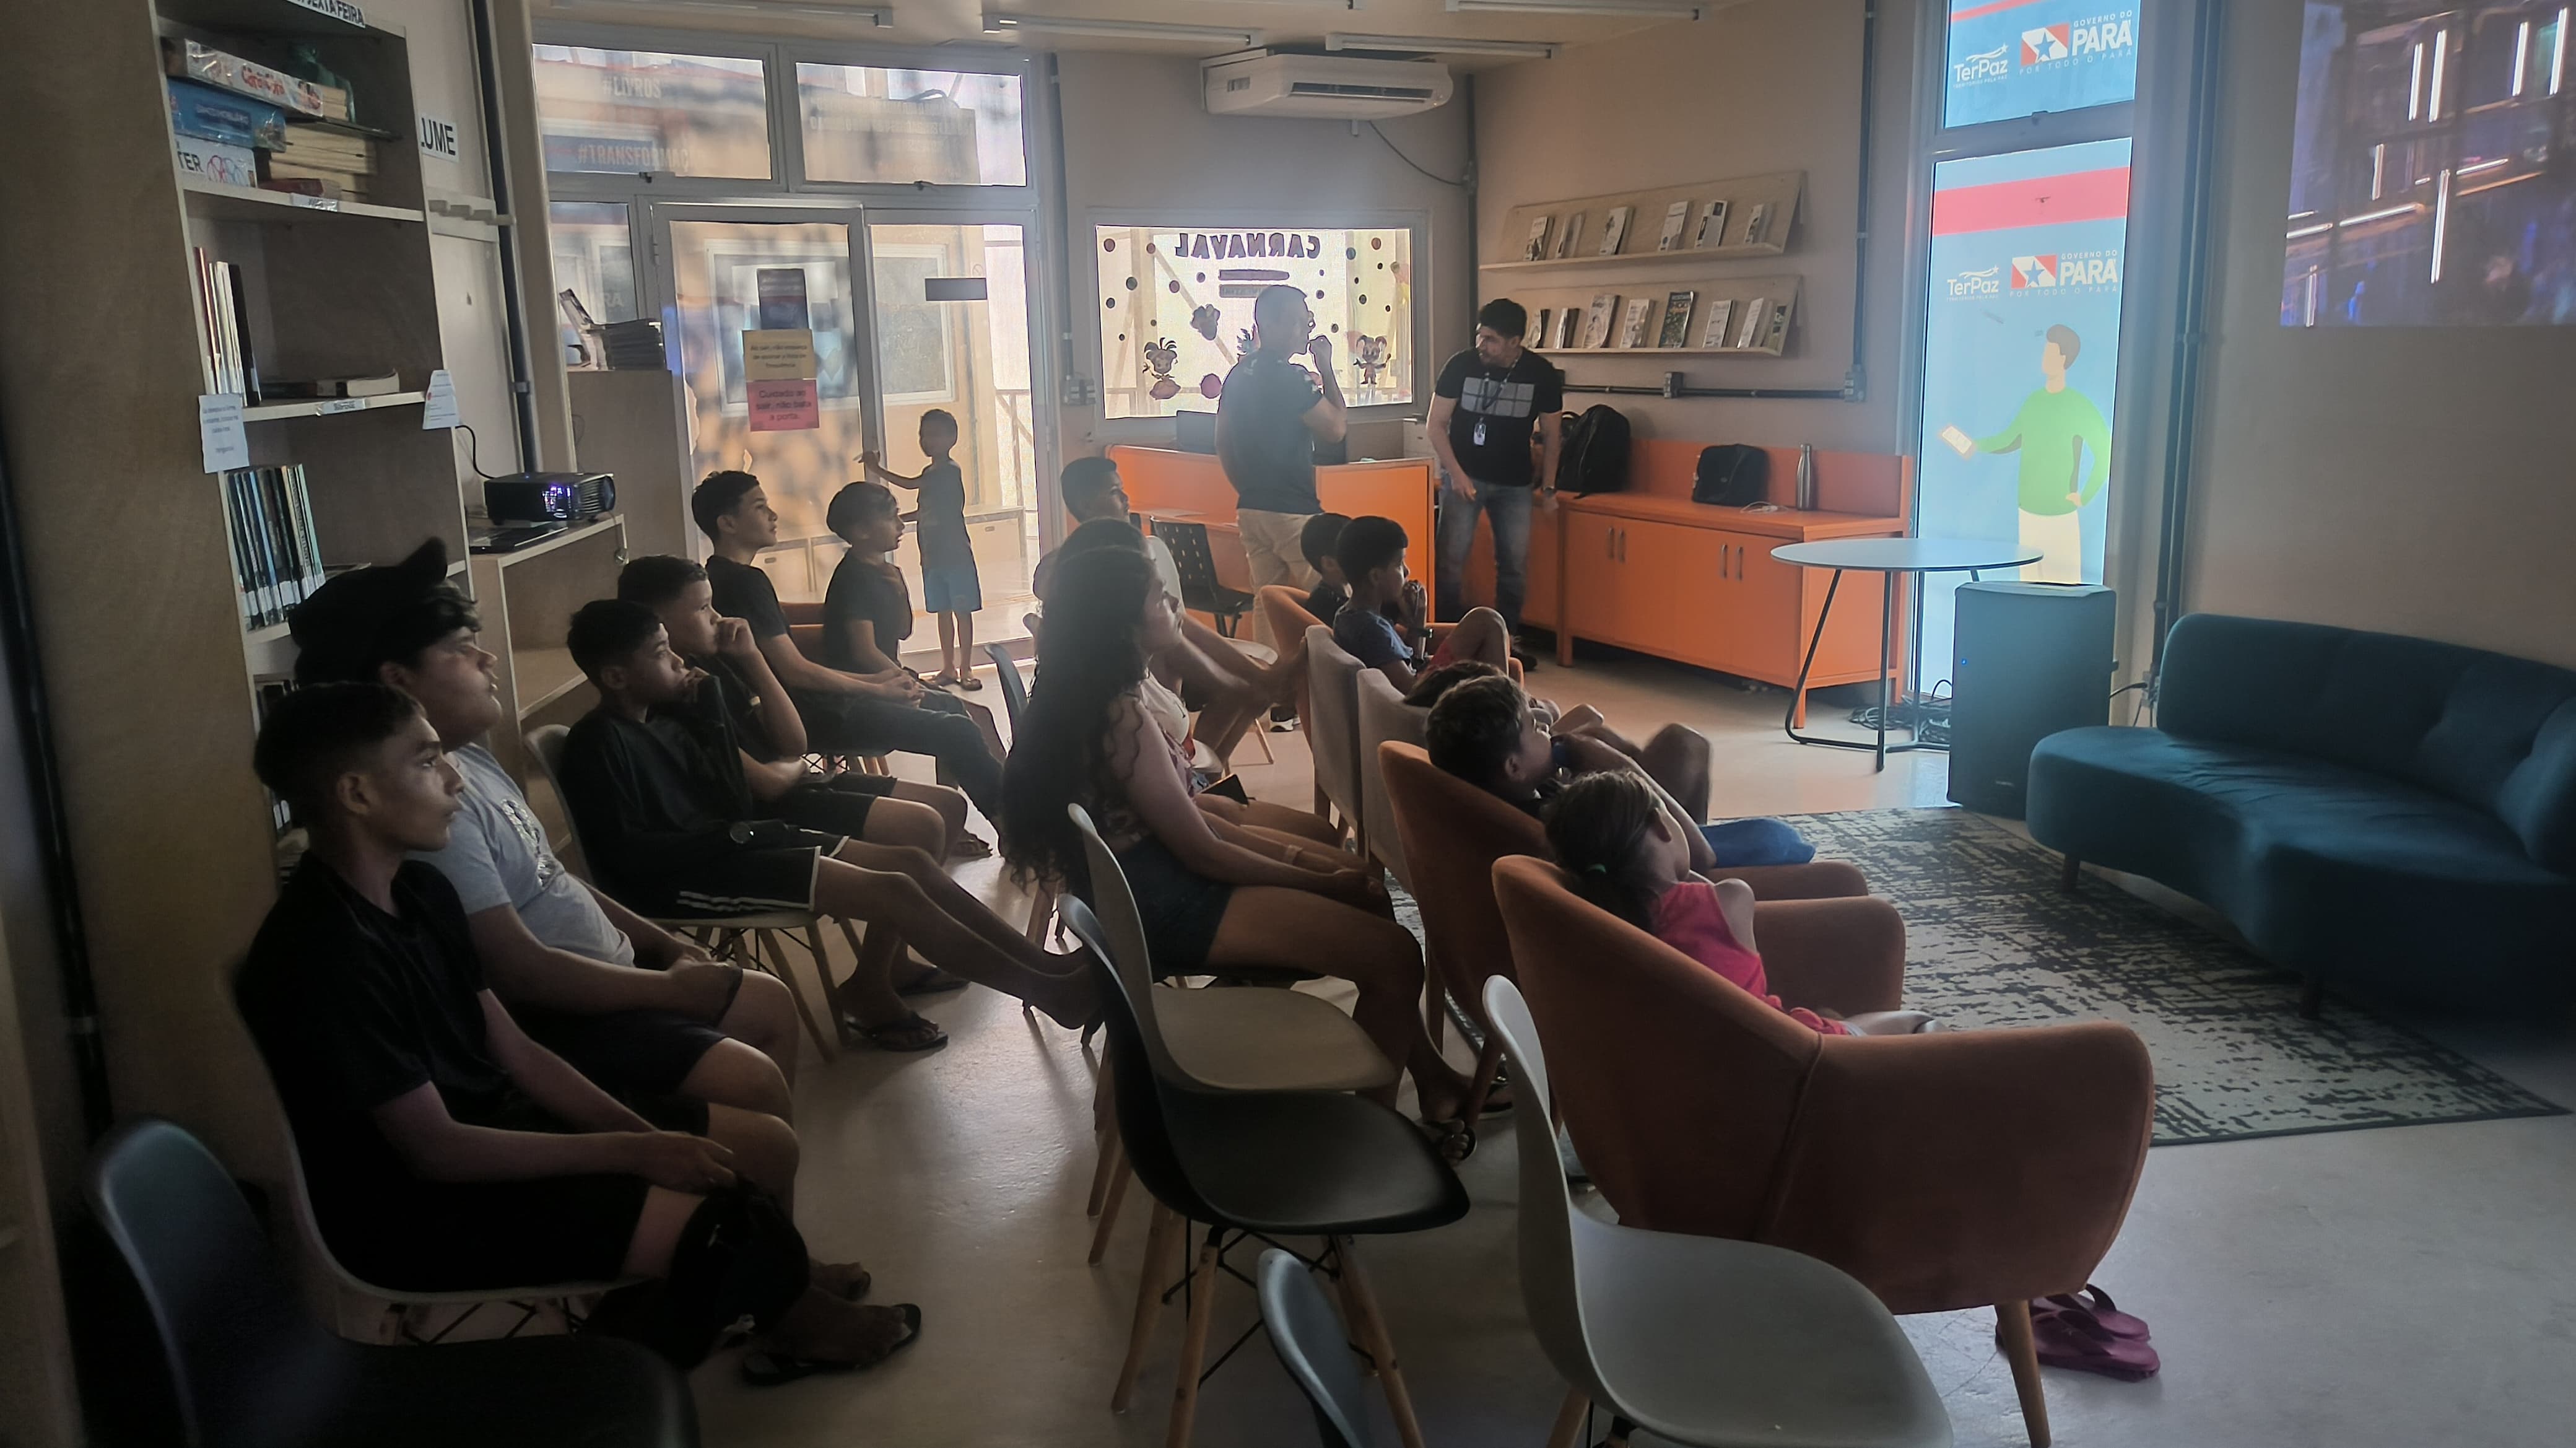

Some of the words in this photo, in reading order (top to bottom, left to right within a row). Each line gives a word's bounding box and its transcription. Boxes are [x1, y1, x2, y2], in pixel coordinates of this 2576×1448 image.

[2074, 13, 2116, 28] GOVERNO
[2120, 9, 2133, 19] DO
[2072, 19, 2133, 56] PARÁ
[1954, 59, 2008, 82] TerPaz
[2019, 66, 2040, 76] POR
[2048, 58, 2079, 71] TODO
[2087, 55, 2094, 63] O
[2061, 251, 2102, 260] GOVERNO
[2060, 258, 2118, 286] PARÁ
[1947, 277, 1999, 296] TerPaz
